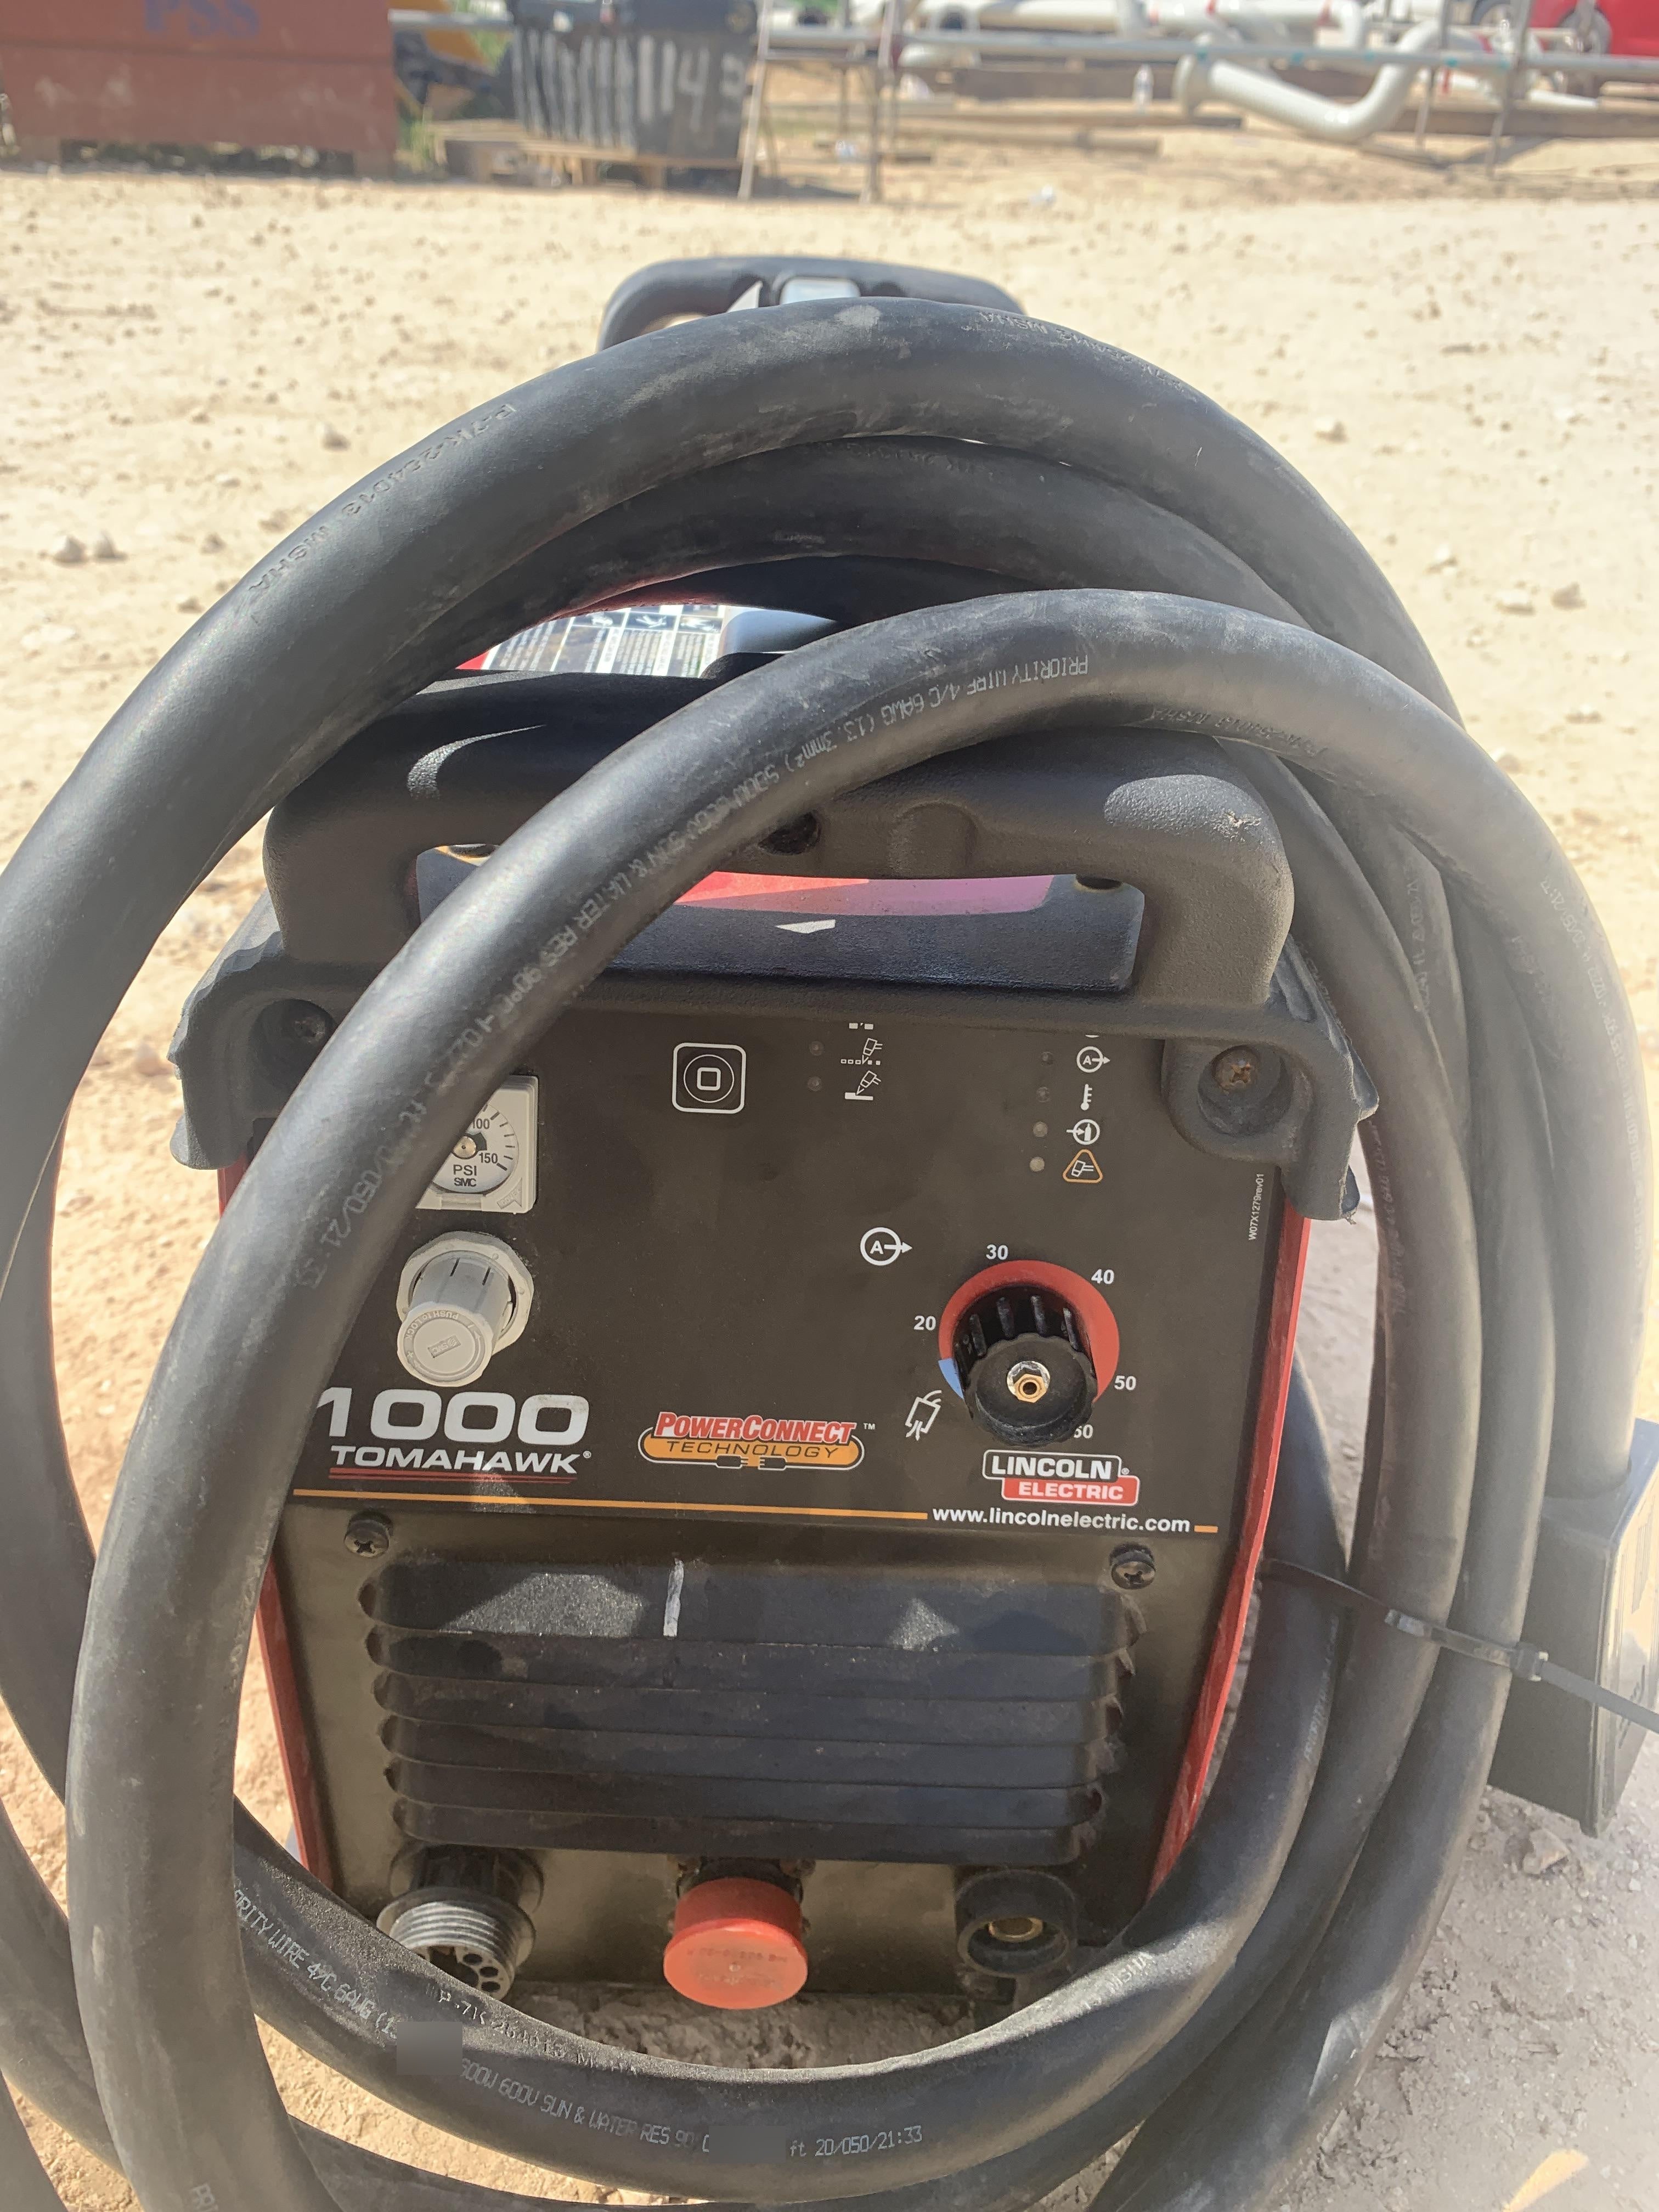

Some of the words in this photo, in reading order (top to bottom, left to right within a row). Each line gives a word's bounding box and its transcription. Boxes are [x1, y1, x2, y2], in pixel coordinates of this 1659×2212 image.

[1012, 655, 1088, 684] PRIORITY
[881, 693, 925, 726] 6AWG
[478, 1153, 498, 1164] 150
[453, 1164, 477, 1176] PSI
[454, 1178, 477, 1187] SMC
[1249, 1174, 1264, 1240] W07X1279rev01
[986, 1244, 1008, 1260] 30
[1091, 1269, 1115, 1285] 40
[433, 1310, 459, 1320] PUSH
[914, 1315, 936, 1330] 20
[404, 1321, 424, 1340] LOCK
[432, 1342, 449, 1355] SMC
[1114, 1375, 1137, 1391] 50
[317, 1387, 590, 1445] 1000
[667, 1441, 838, 1459] TECHNOLOGY
[1018, 1481, 1124, 1500] ELECTRIC
[933, 1506, 1190, 1533] www.lincolnelectric.com
[268, 1929, 309, 1969] WIRE
[307, 1963, 337, 1992] 4/C
[334, 1984, 376, 2019] 6AWG
[498, 2078, 540, 2106] 600V
[541, 2095, 573, 2119] SUN
[574, 2106, 585, 2124] &
[640, 2123, 670, 2145] RES
[789, 2140, 806, 2157] ft
[815, 2125, 922, 2157] 20/050/21:33
